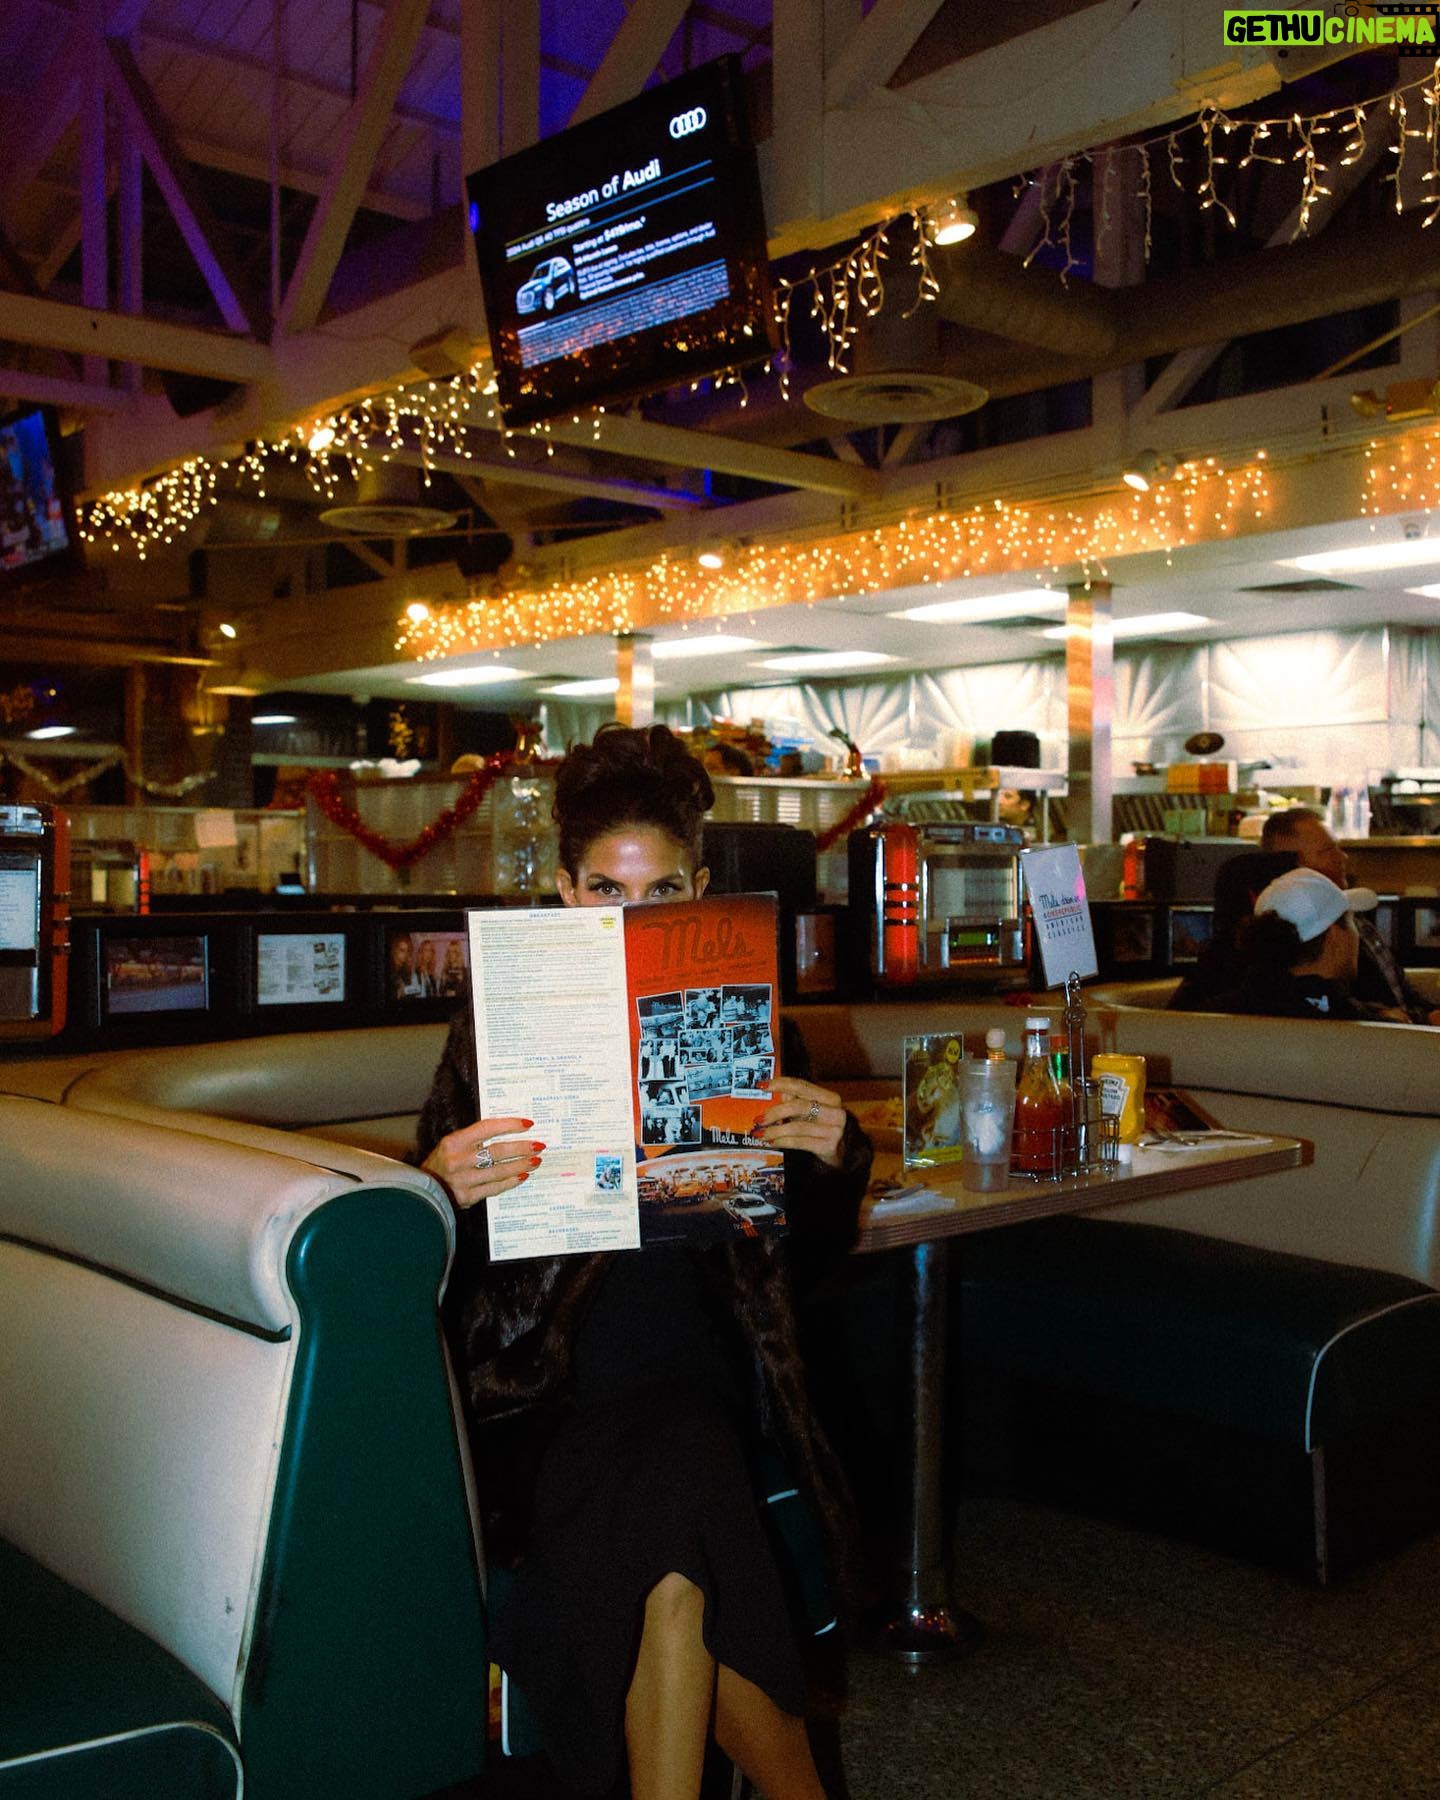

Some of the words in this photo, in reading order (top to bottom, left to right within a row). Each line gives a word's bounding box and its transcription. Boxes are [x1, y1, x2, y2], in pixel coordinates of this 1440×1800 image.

[546, 186, 600, 222] Season
[602, 175, 620, 199] of
[622, 158, 661, 191] Audi
[642, 915, 755, 969] Mels
[709, 1125, 738, 1144] Mels
